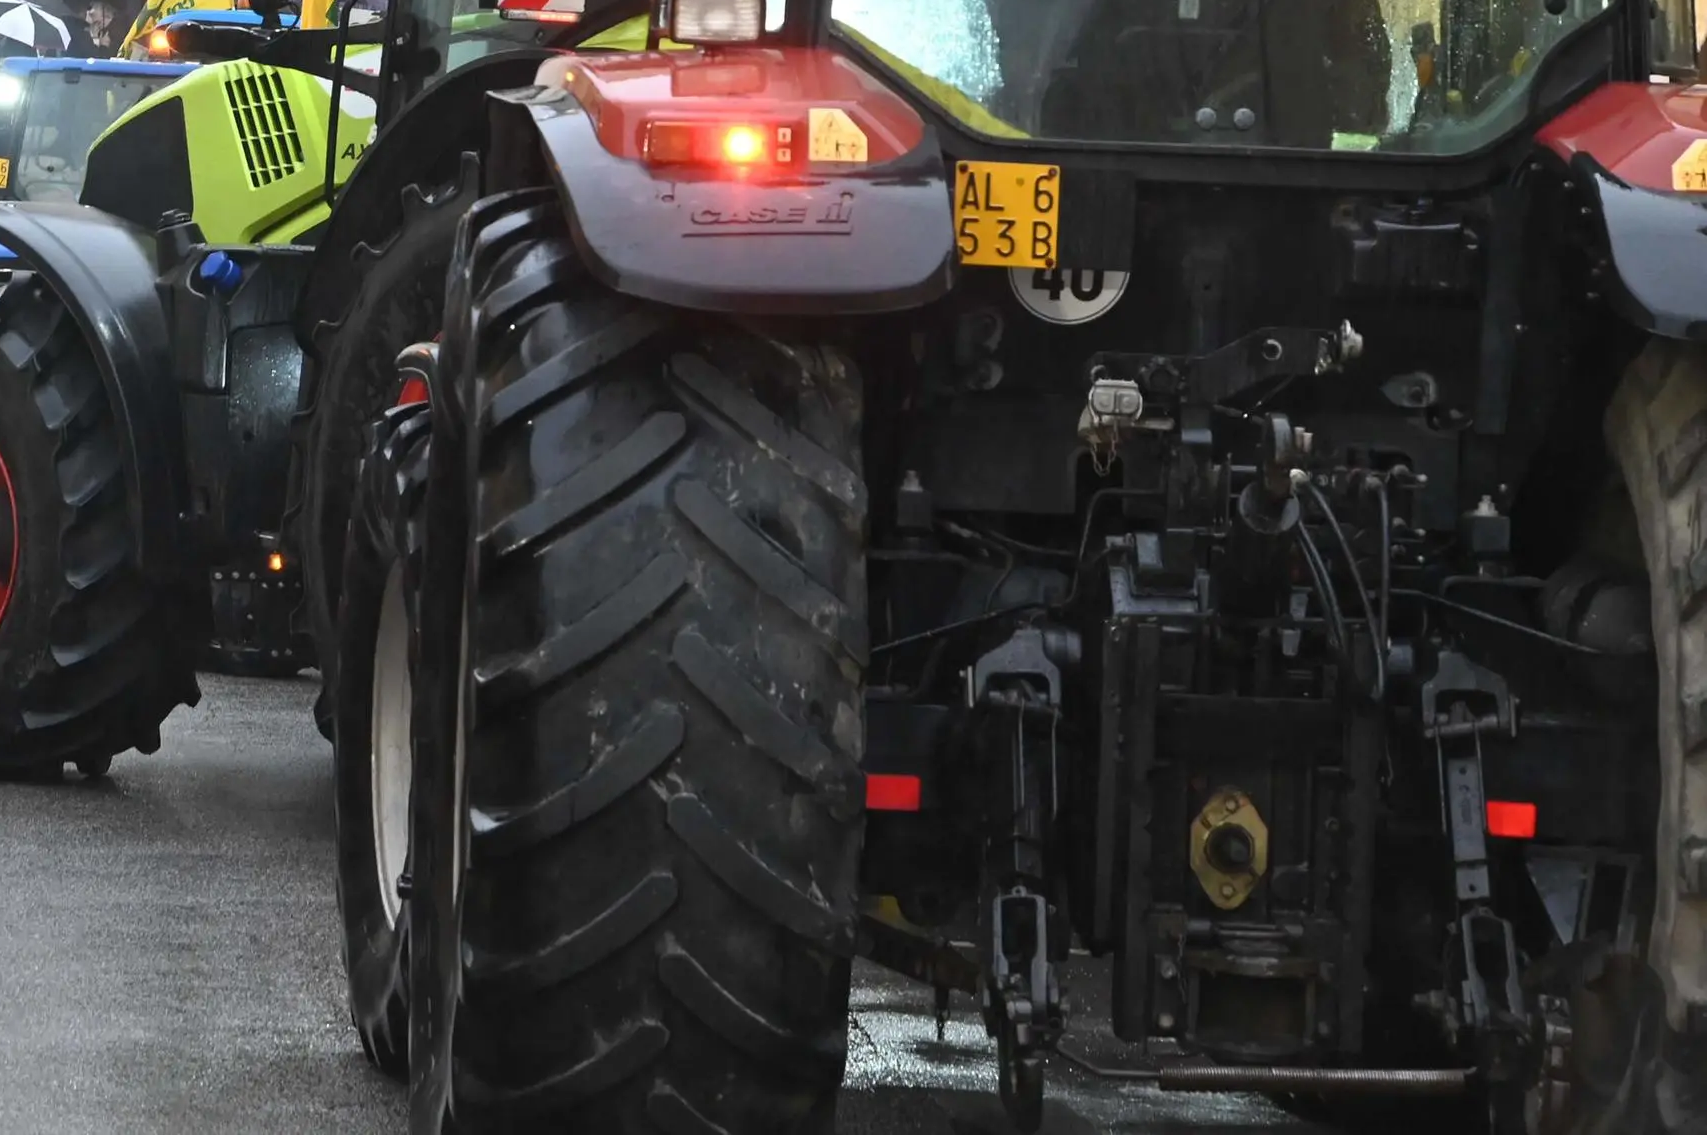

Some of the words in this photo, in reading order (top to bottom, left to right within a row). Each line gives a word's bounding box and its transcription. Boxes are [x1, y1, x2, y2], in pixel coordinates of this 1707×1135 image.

[961, 172, 1005, 212] AL
[1034, 174, 1054, 213] 6
[690, 206, 809, 225] CASE
